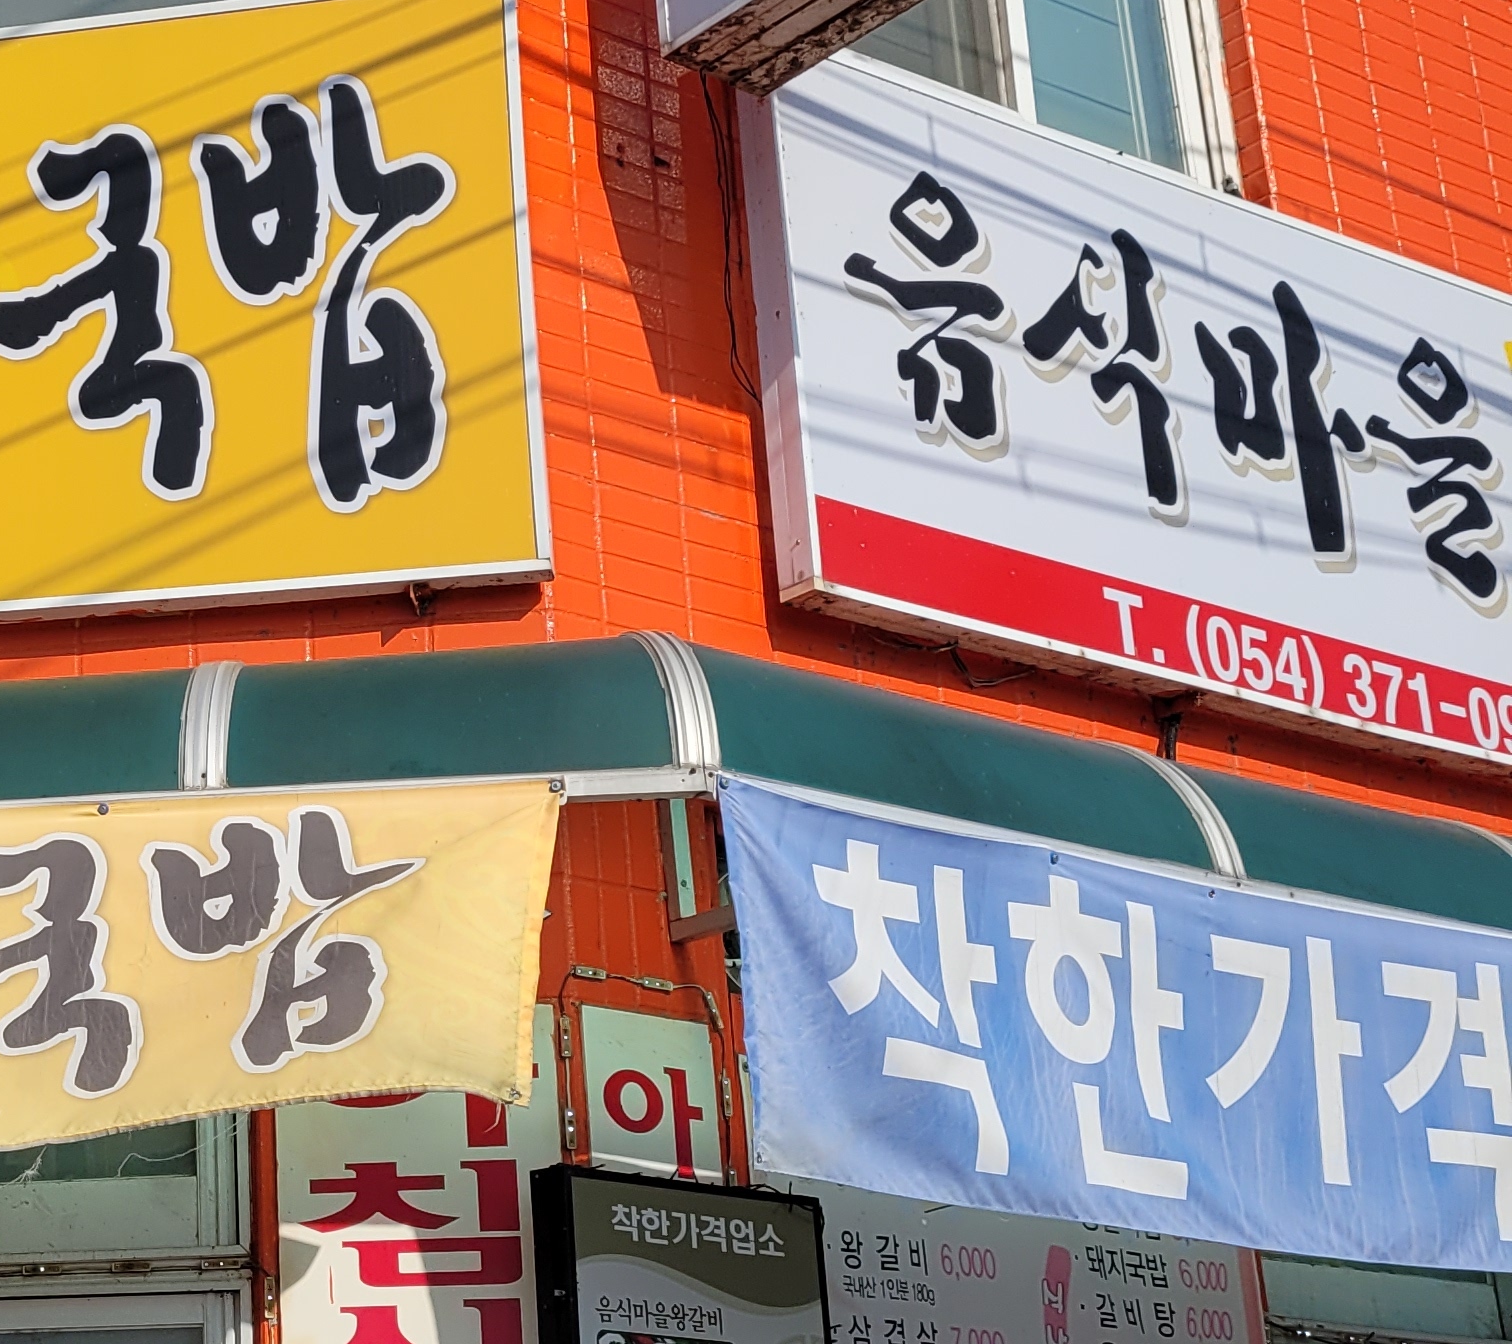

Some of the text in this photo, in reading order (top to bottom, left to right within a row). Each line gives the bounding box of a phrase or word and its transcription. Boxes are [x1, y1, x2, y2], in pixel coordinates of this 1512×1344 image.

[842, 169, 1501, 606] 음식마을
[1102, 586, 1165, 664] T.
[1186, 604, 1324, 709] (054)
[611, 1203, 785, 1257] 착한가격업소
[941, 1243, 996, 1281] 6,000
[1085, 1245, 1228, 1293] 돼지국밥 6,000
[842, 1275, 876, 1298] 국내산
[1187, 1306, 1233, 1342] 6,000
